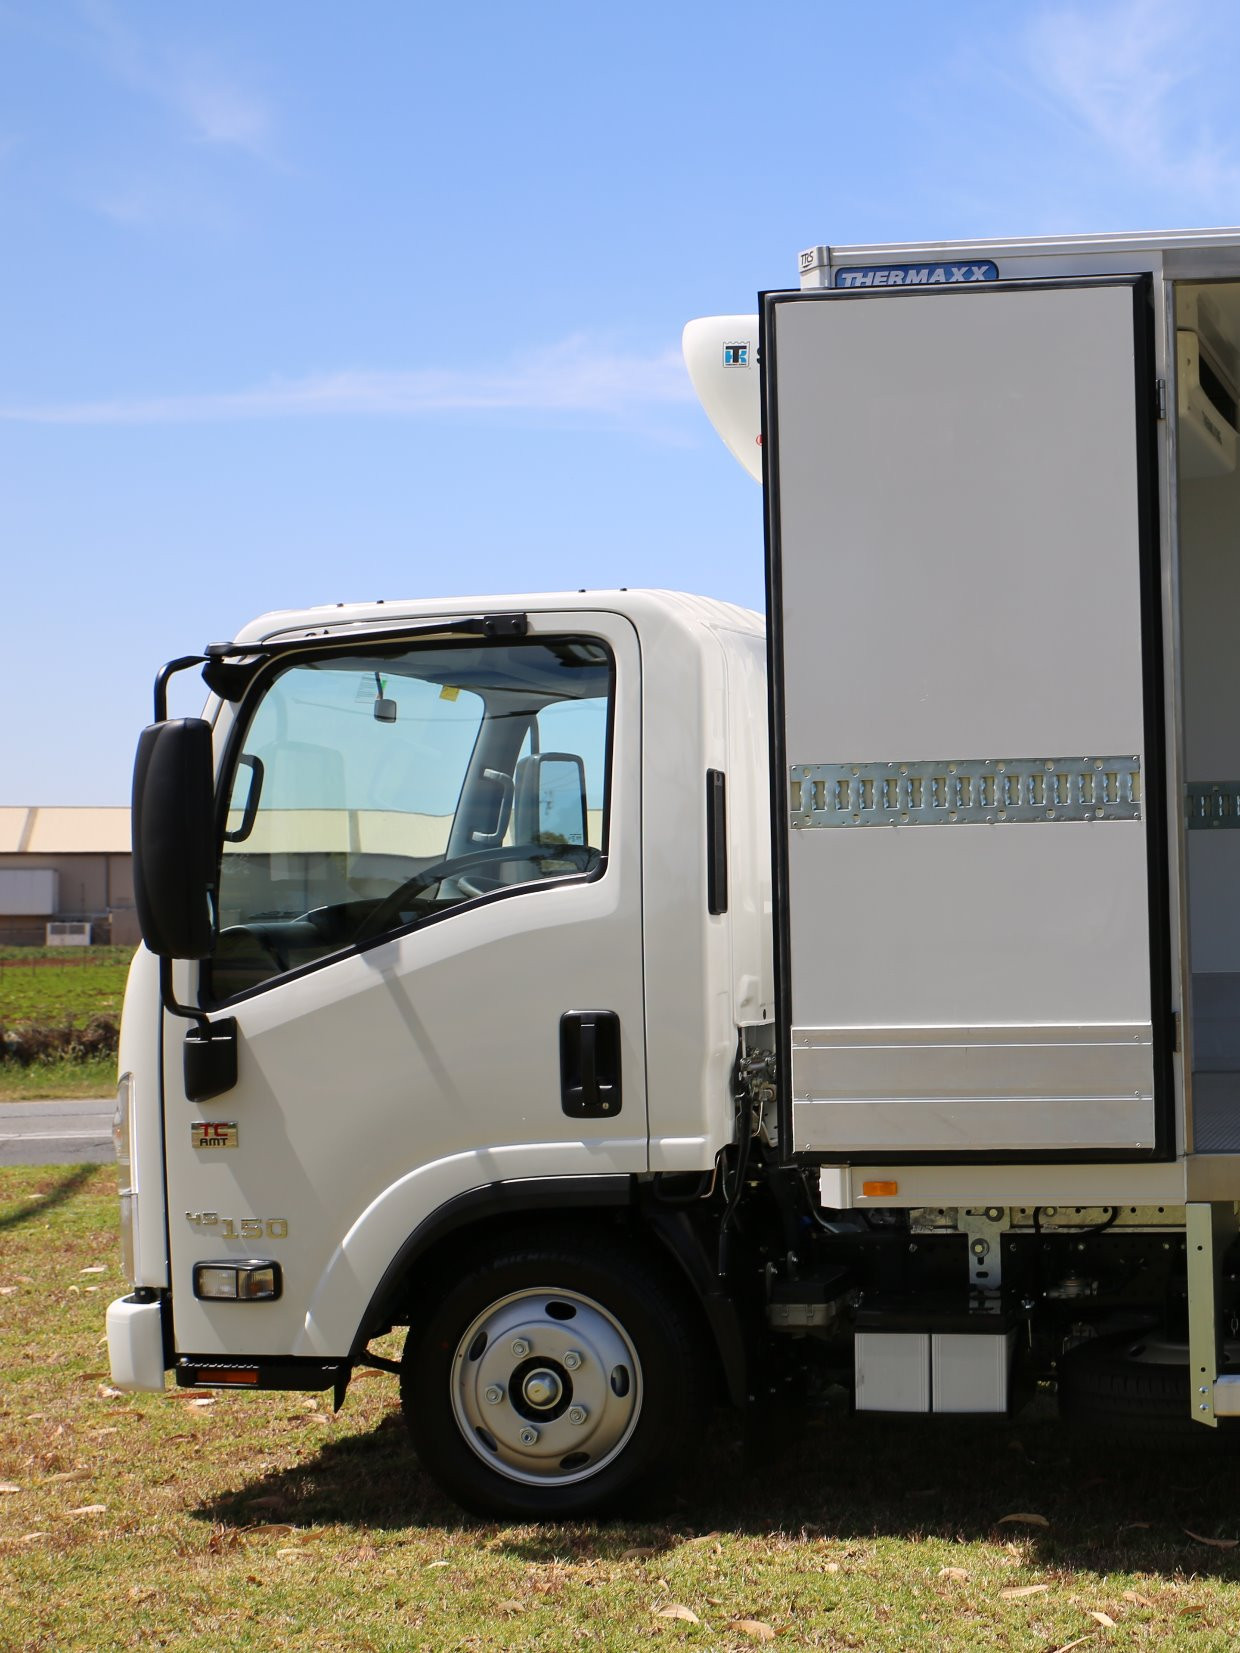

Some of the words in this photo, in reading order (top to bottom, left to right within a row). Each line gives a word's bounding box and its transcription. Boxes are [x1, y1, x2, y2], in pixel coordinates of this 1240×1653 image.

[841, 265, 990, 288] THERMAXX
[199, 1123, 229, 1137] TC
[199, 1137, 229, 1147] AMT
[220, 1217, 289, 1240] 150
